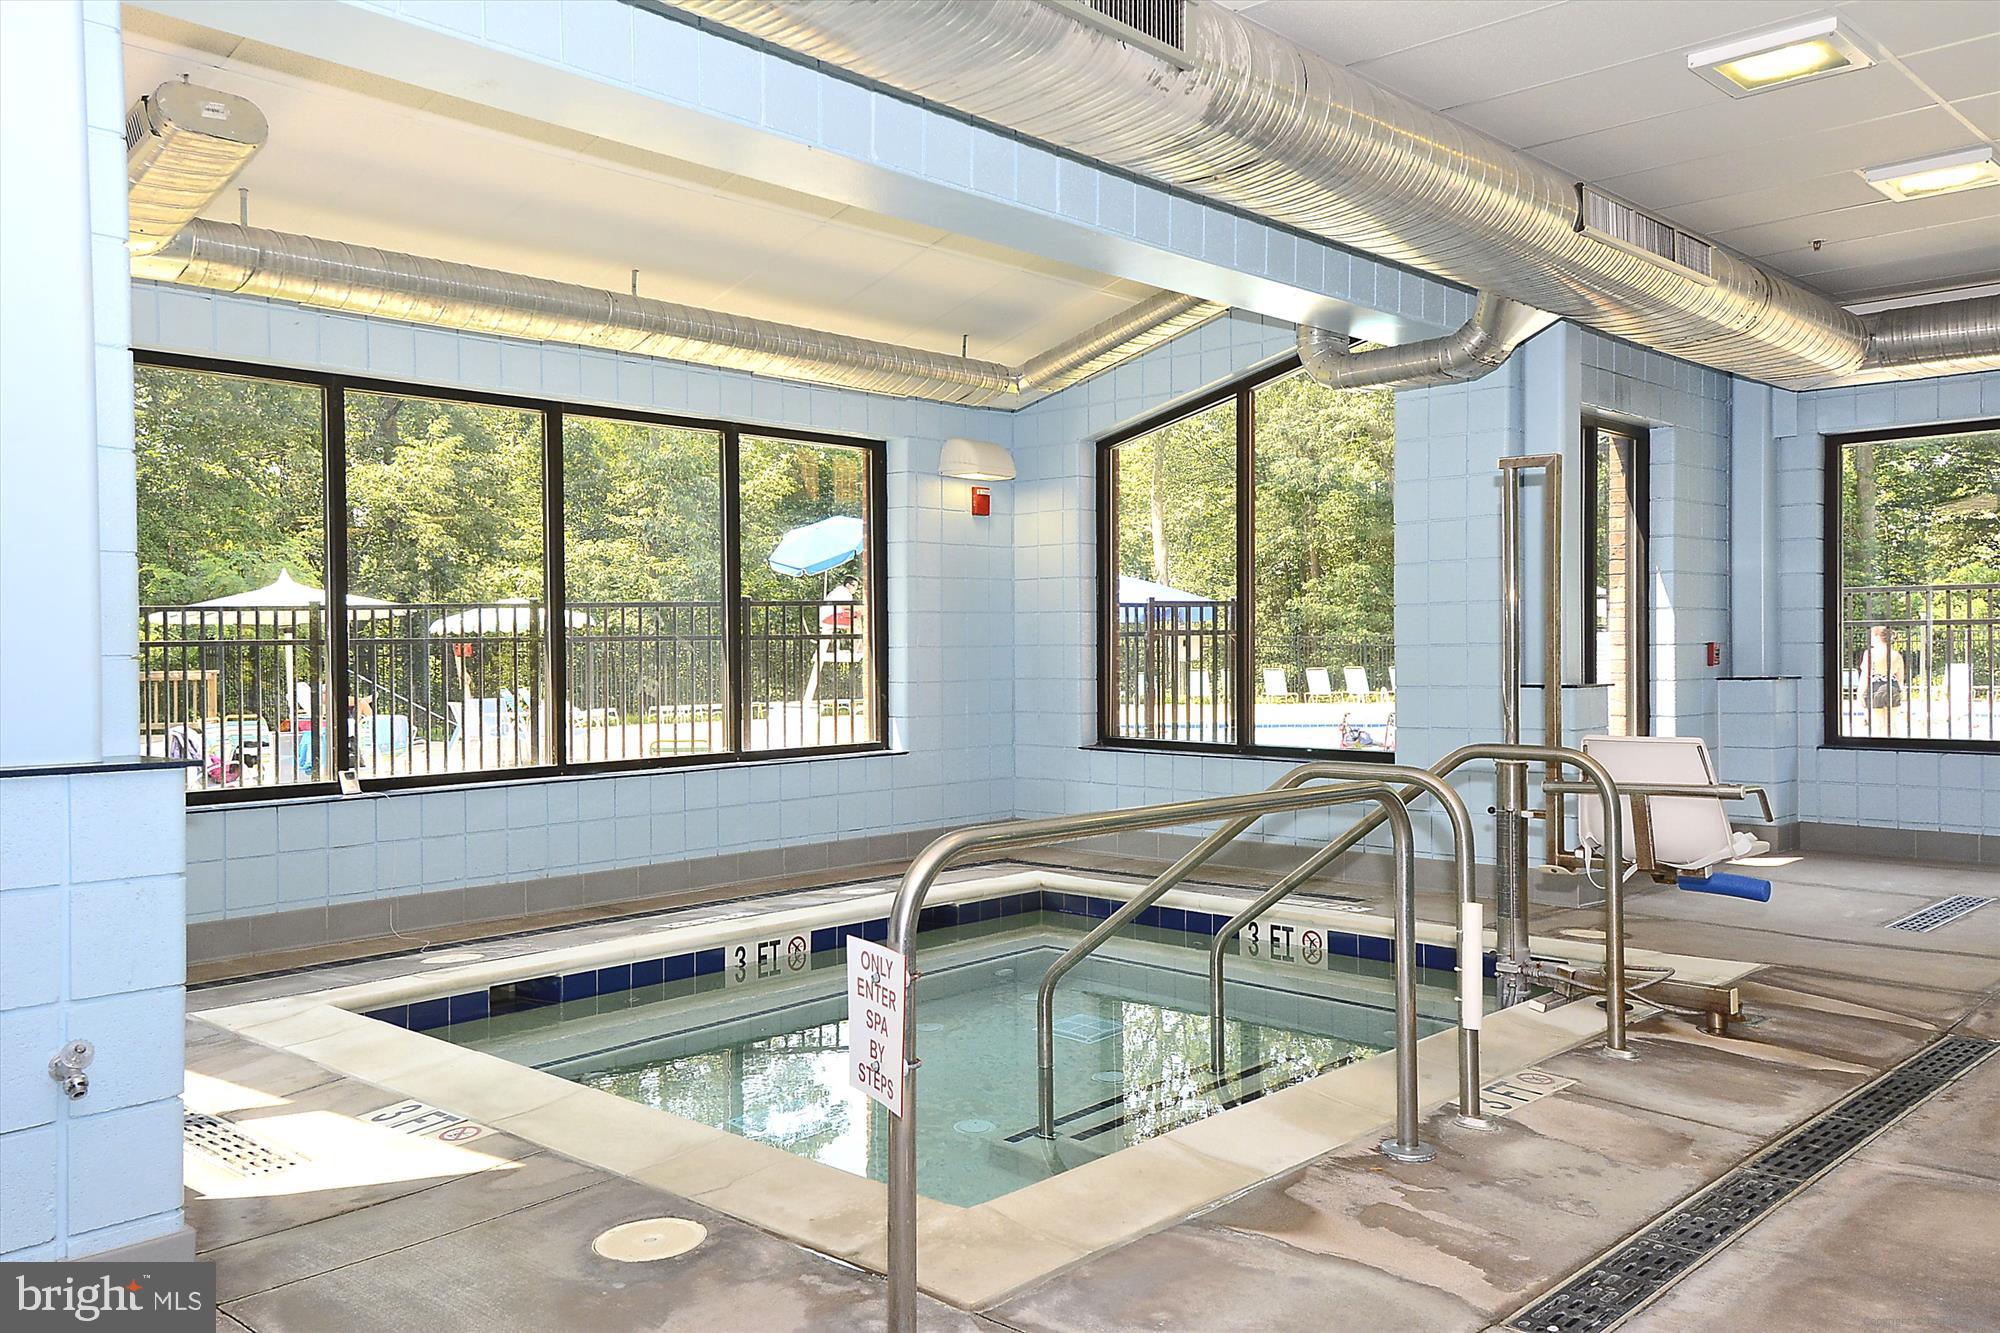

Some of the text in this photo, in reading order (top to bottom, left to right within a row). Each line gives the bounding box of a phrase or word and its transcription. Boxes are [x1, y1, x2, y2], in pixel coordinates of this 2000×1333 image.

[860, 950, 894, 979] ONLY
[857, 976, 897, 1012] ENTER
[865, 1009, 889, 1038] SPA
[869, 1039, 885, 1063] BY
[858, 1062, 894, 1101] STEPS
[1481, 1080, 1544, 1102] FT
[370, 1104, 461, 1134] 3 FT
